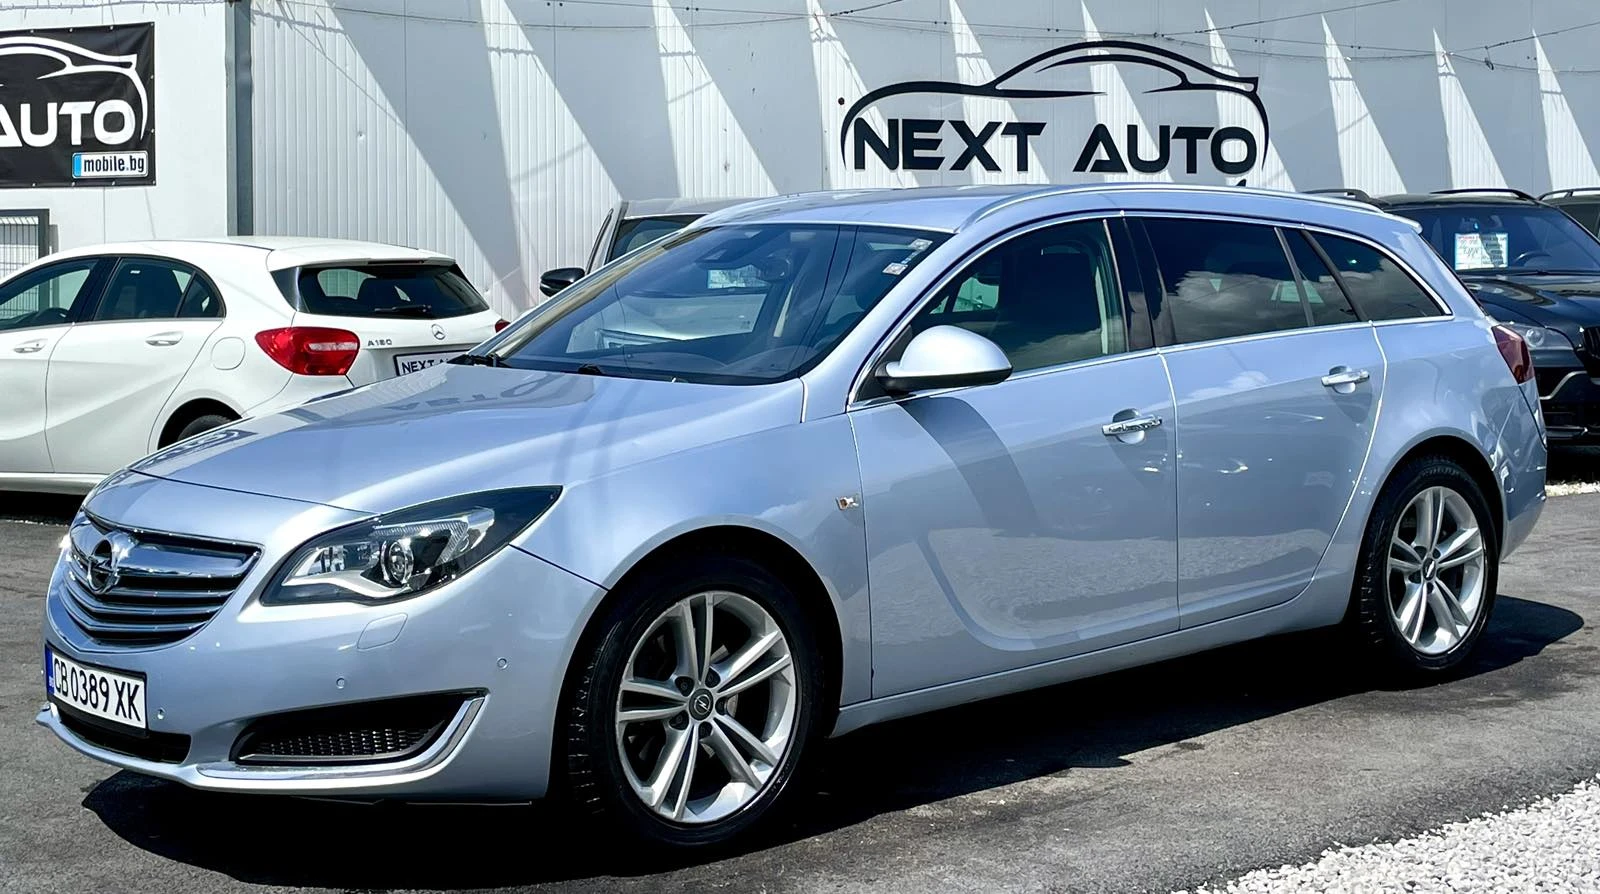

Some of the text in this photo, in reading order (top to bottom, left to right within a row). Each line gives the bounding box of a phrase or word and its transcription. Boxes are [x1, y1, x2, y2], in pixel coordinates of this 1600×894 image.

[83, 154, 145, 173] mobile.bg
[853, 116, 1258, 175] NEXT AUTO
[401, 359, 435, 374] NEXT
[54, 658, 142, 722] CB 0389 XK
